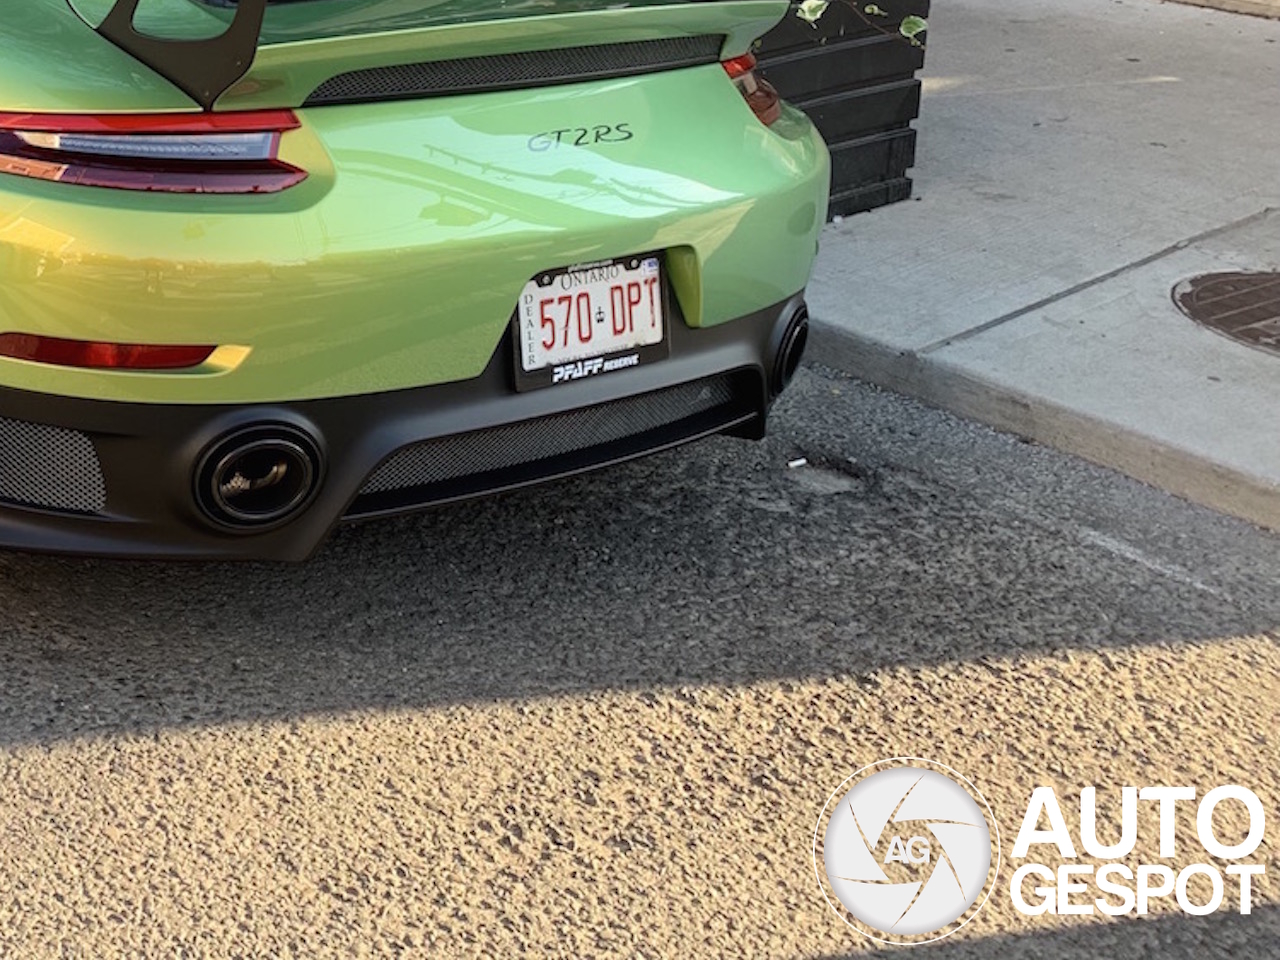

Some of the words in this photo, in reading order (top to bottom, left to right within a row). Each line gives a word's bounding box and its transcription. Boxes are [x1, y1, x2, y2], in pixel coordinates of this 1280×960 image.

[561, 266, 619, 291] ONTARIO
[524, 293, 537, 366] DEALER
[539, 291, 593, 352] 570
[610, 276, 658, 337] DPT
[552, 357, 604, 383] PFAFF
